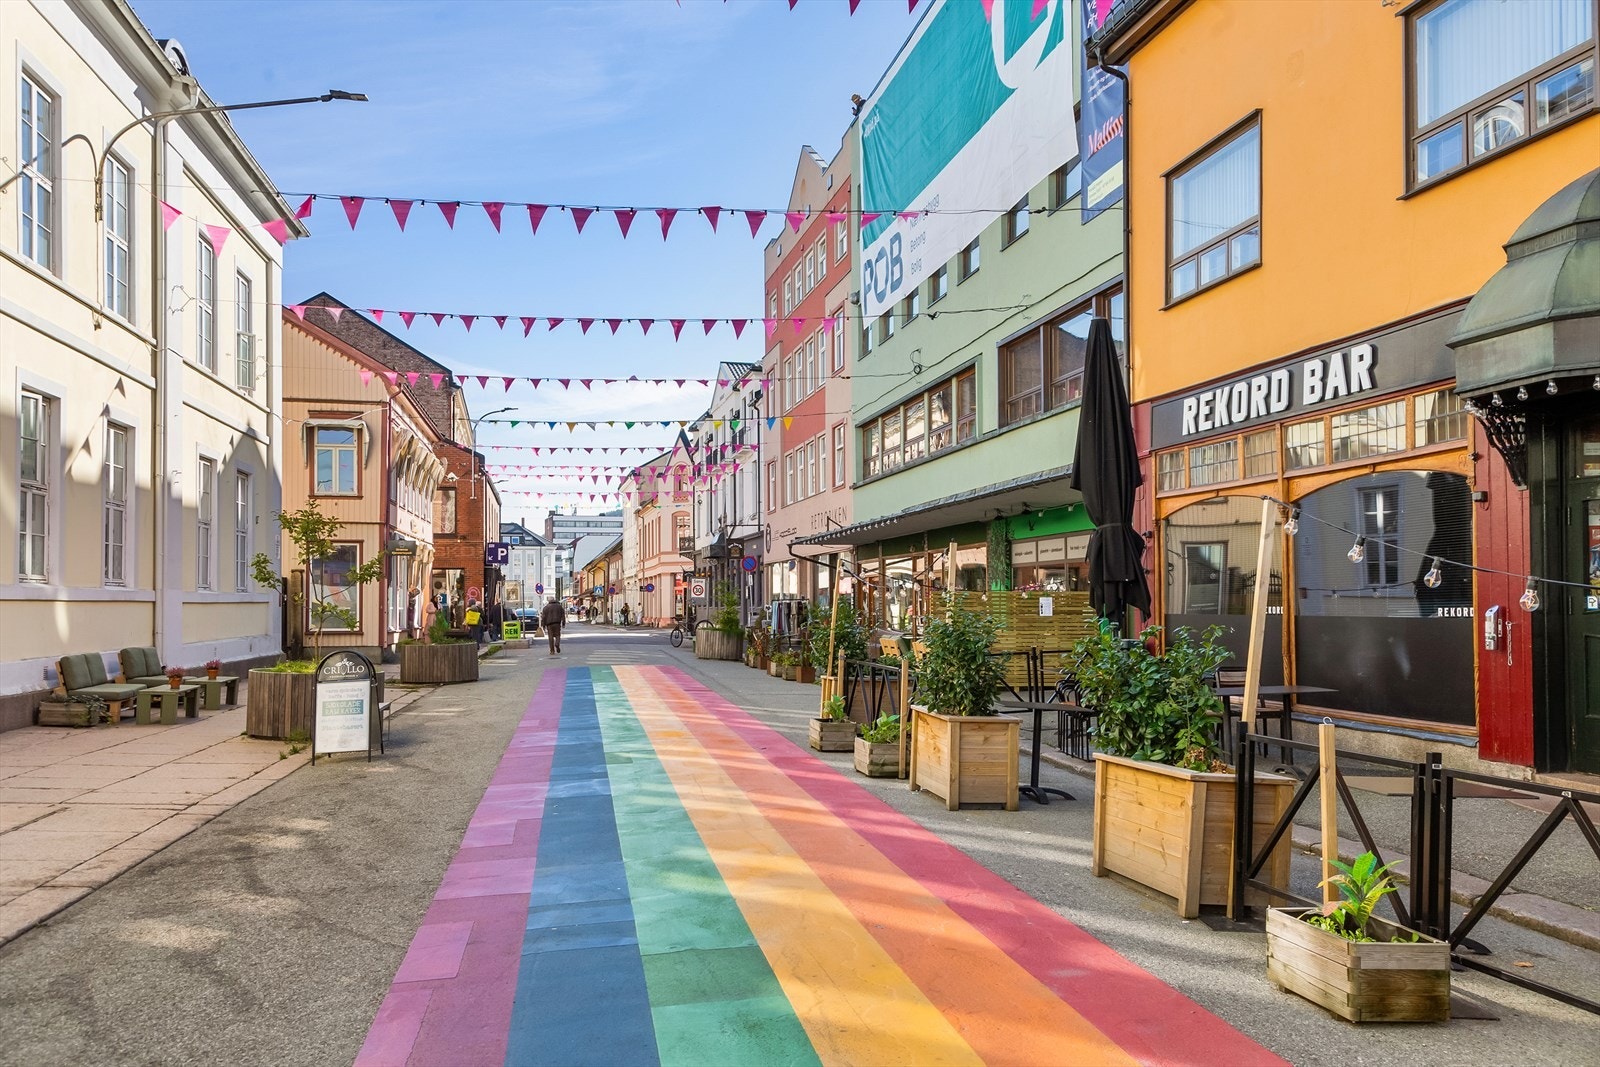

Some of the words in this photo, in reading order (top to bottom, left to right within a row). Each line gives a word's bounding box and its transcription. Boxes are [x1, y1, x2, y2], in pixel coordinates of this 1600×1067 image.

[864, 232, 904, 315] POB
[1182, 368, 1290, 436] REKORD
[1302, 343, 1374, 405] BAR
[497, 547, 508, 561] P
[1437, 607, 1475, 617] REKORD
